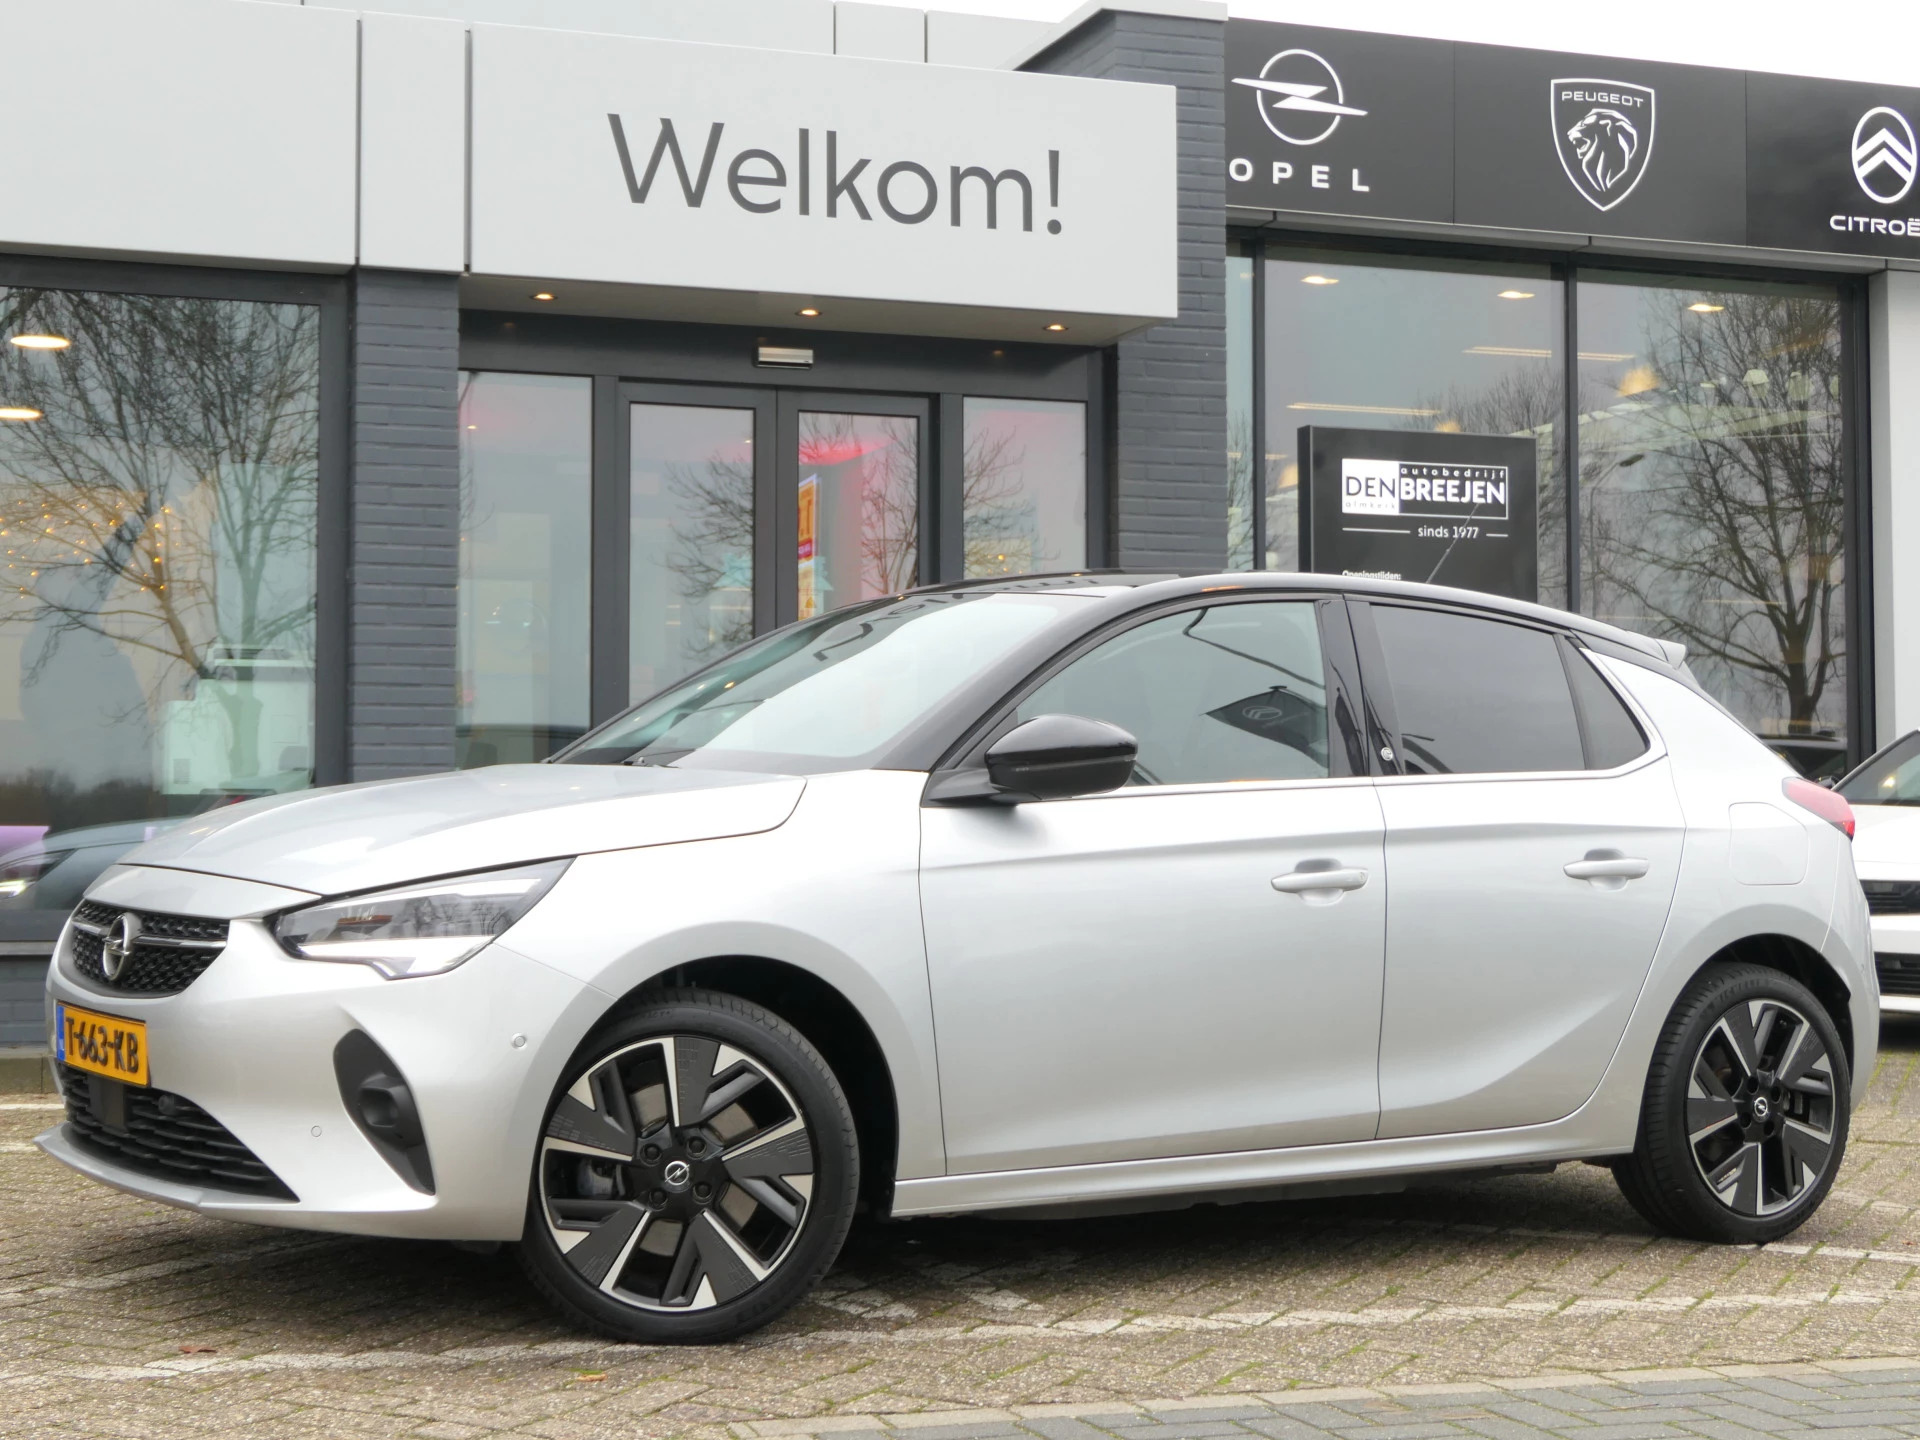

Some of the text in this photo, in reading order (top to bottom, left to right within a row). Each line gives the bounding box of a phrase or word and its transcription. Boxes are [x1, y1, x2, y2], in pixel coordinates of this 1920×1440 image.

[1562, 91, 1644, 108] PEUGEOT
[607, 113, 1062, 235] Welkom!
[1229, 158, 1370, 192] OPEL
[1401, 467, 1504, 479] autobedrijf
[1346, 476, 1505, 504] DEN BREEJEN
[1418, 525, 1479, 539] sinds 1977
[65, 1017, 139, 1074] T-663-KB
